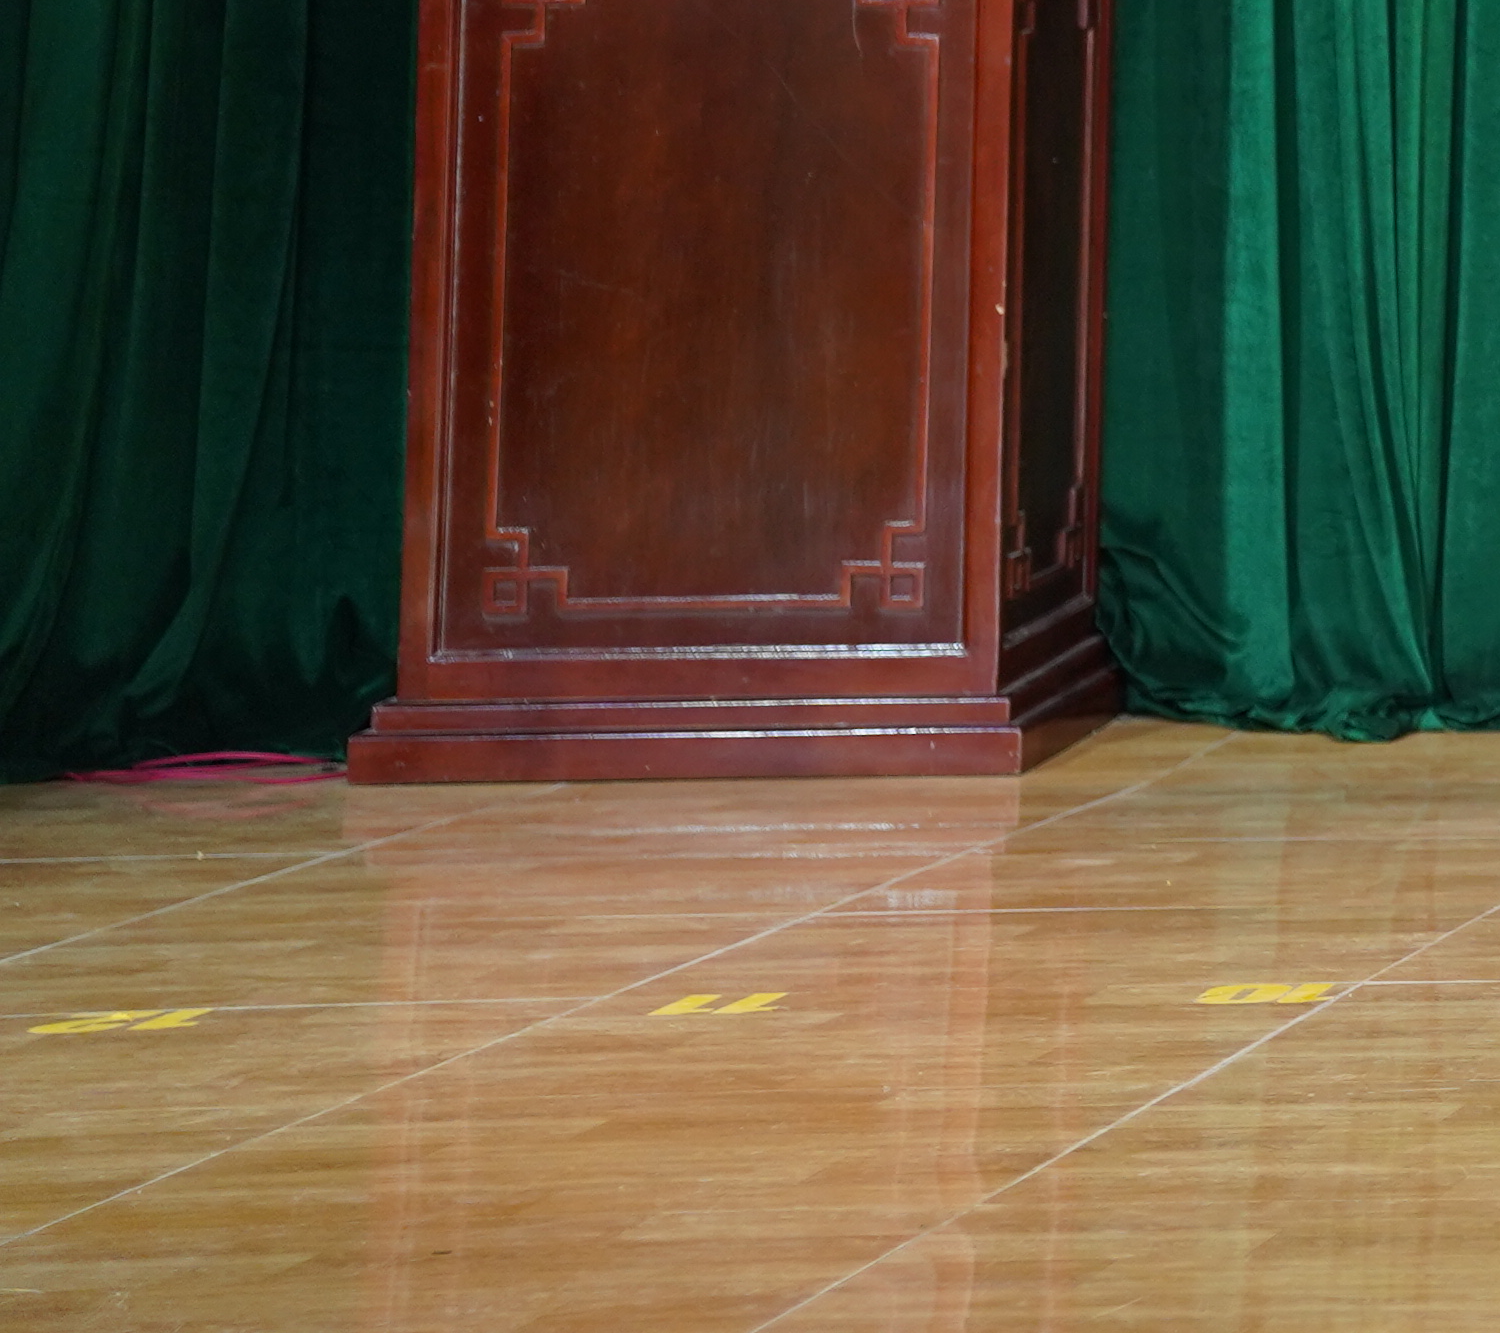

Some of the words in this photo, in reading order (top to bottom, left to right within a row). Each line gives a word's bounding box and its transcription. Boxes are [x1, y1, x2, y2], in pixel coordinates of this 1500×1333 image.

[646, 992, 790, 1017] 11
[1197, 983, 1341, 1004] 10
[27, 1007, 214, 1035] 12
